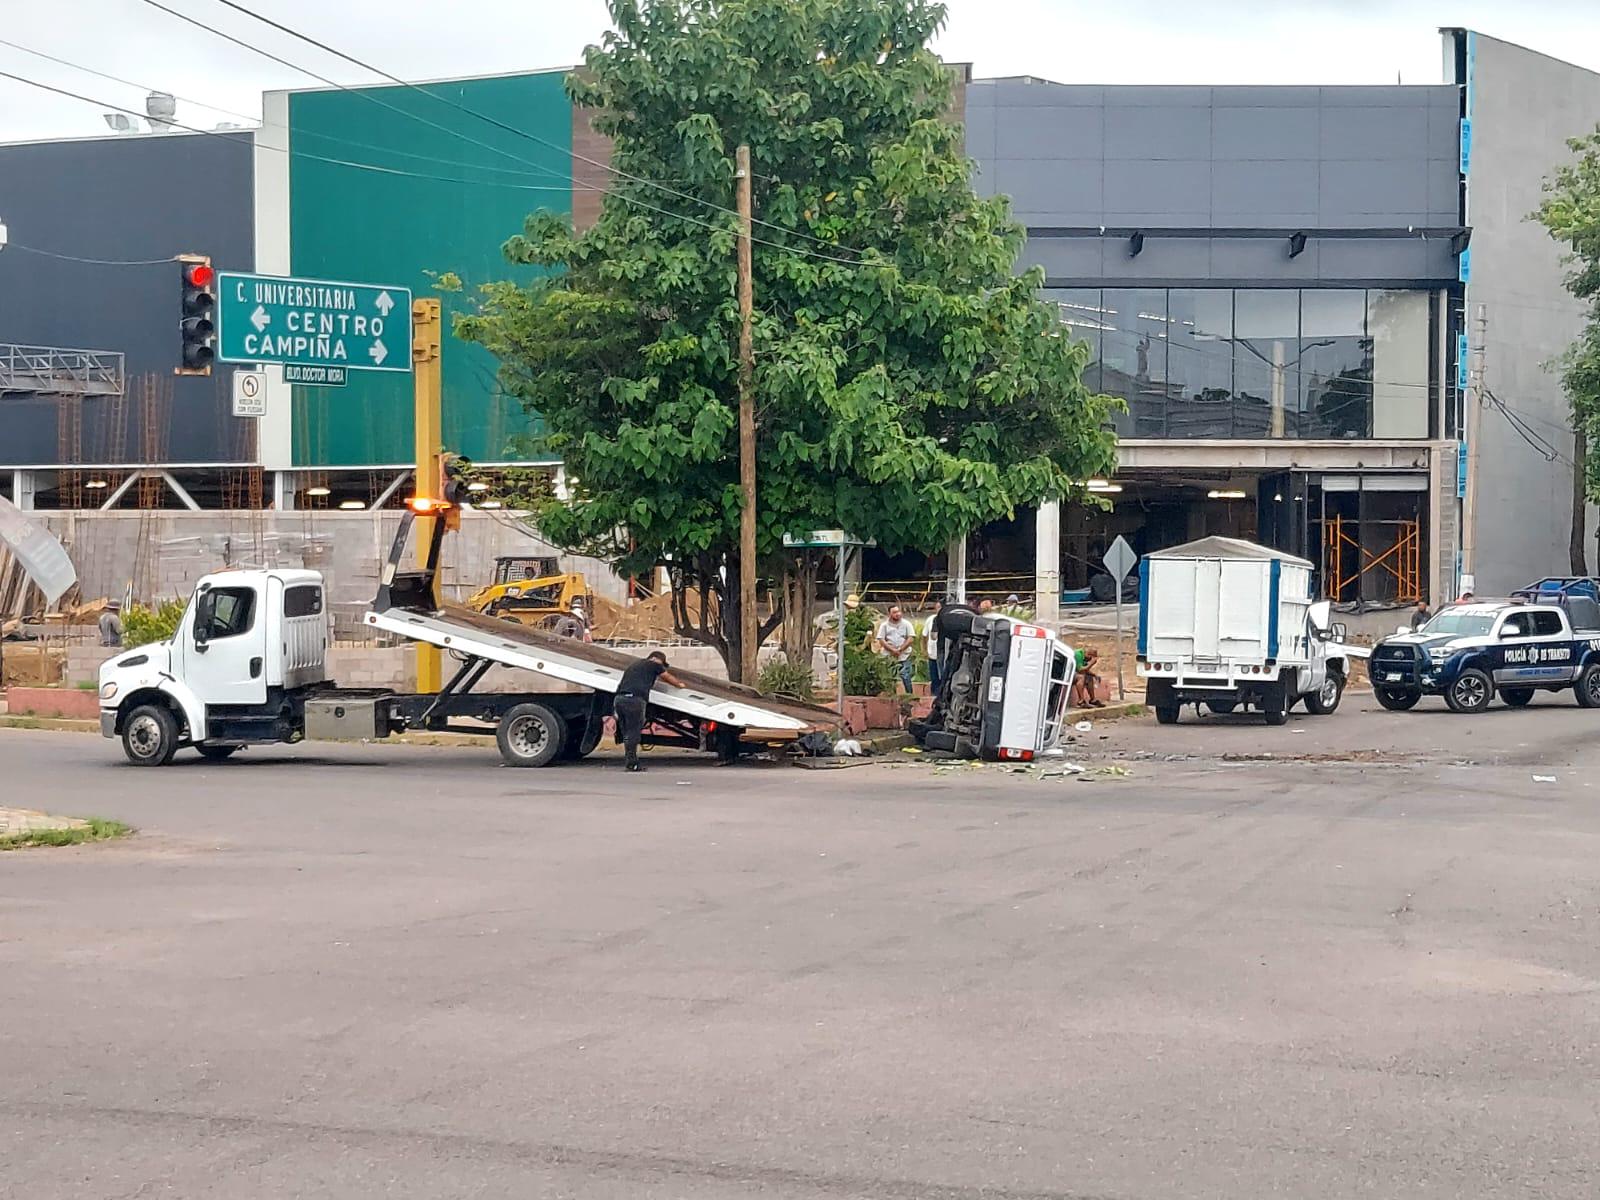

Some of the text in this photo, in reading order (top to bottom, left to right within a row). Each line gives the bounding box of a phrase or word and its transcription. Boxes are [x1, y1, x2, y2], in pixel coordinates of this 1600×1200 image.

[237, 282, 356, 310] C. UNIVERSITARIA
[287, 311, 384, 337] CENTRO
[245, 334, 347, 360] CAMPIÑA
[302, 367, 326, 382] DOCTOR
[327, 368, 344, 382] MORA
